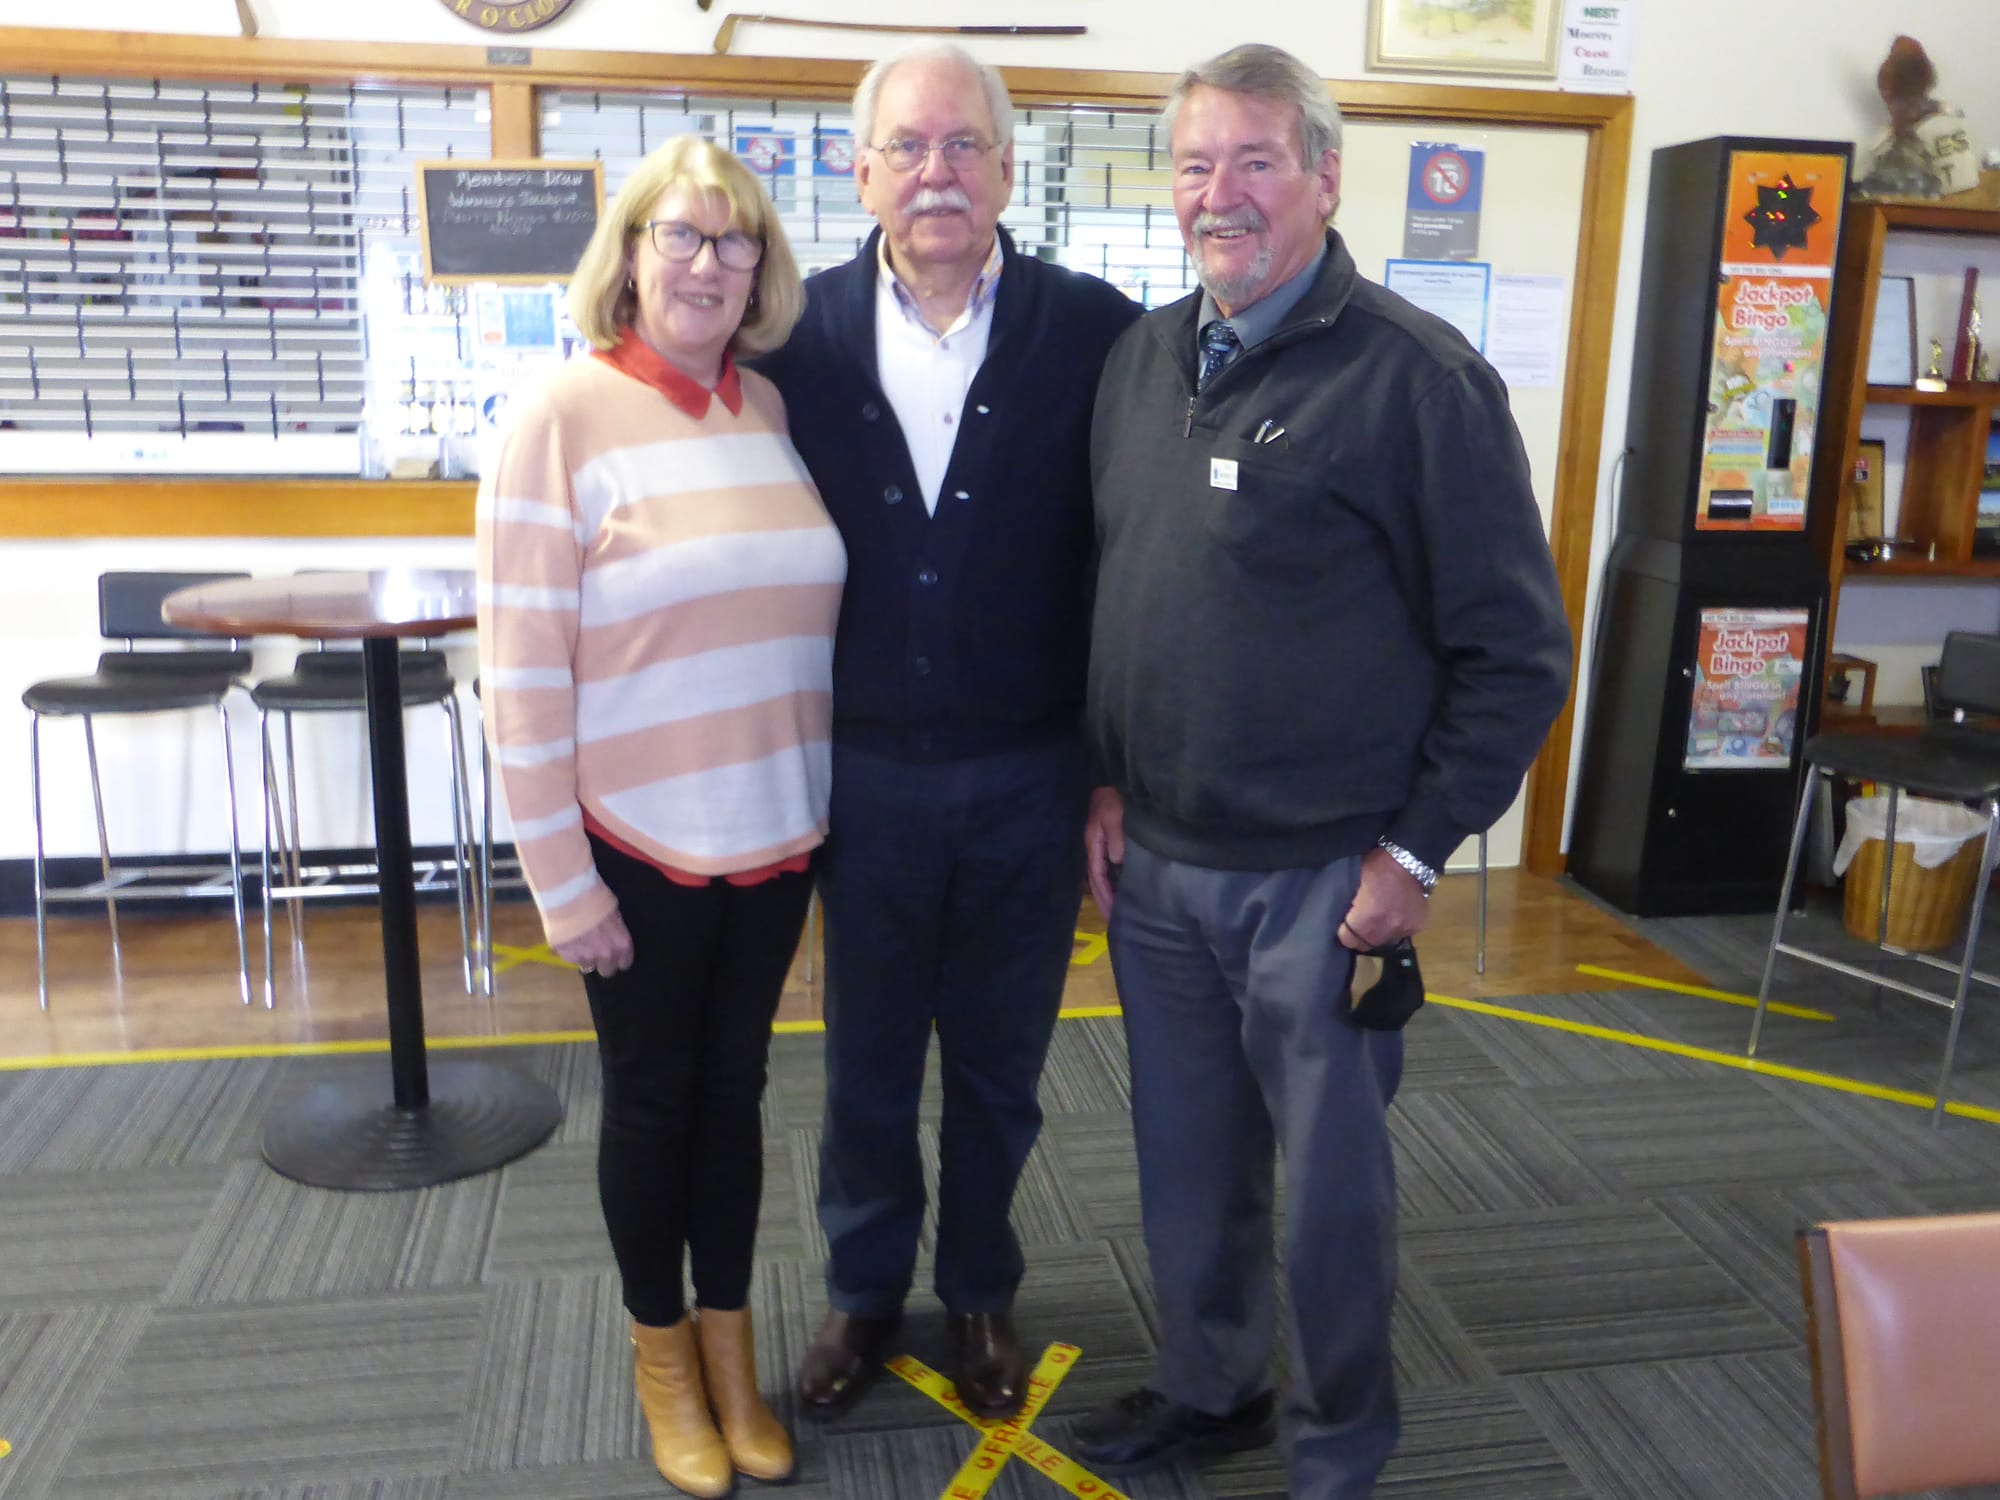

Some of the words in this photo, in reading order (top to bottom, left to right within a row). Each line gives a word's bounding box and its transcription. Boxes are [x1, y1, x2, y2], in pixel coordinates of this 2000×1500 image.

[1736, 280, 1815, 310] Jackpot
[1733, 305, 1790, 332] Bingo
[1713, 631, 1790, 658] Jackpot
[1710, 653, 1766, 679] Bingo
